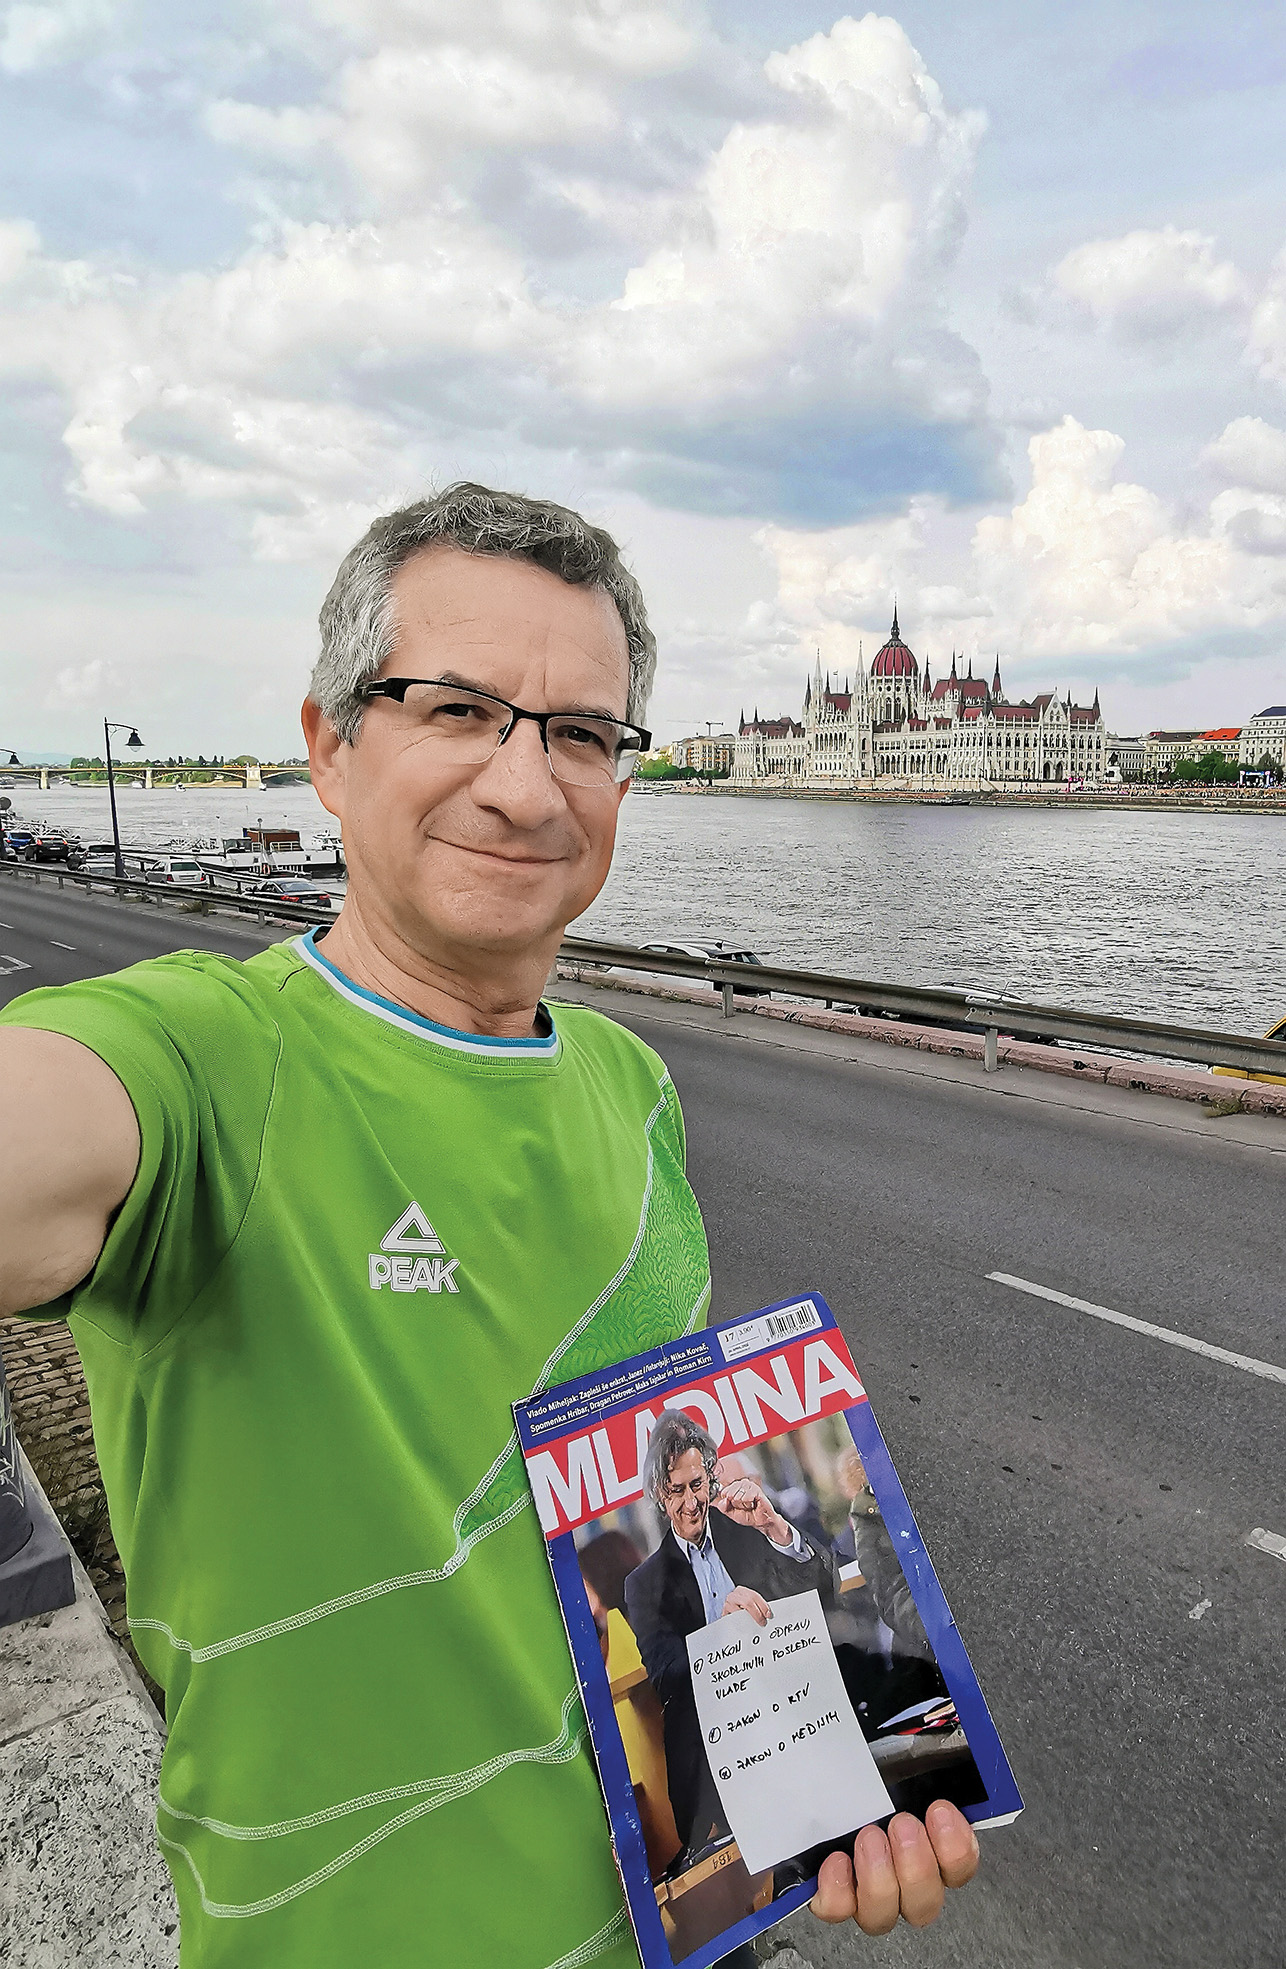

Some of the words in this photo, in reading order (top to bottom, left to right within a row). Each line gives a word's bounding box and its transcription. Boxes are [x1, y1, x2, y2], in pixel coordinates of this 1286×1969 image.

[368, 1253, 461, 1293] PEAK
[724, 1332, 735, 1342] 17
[527, 1407, 548, 1419] Vlado
[547, 1395, 579, 1412] Miheljak:
[670, 1352, 686, 1362] Nika
[686, 1342, 710, 1356] Kovač,
[530, 1415, 567, 1433] Spomenka
[567, 1405, 590, 1419] Hribar,
[589, 1397, 611, 1410] Dragan
[666, 1369, 674, 1377] in
[673, 1362, 697, 1374] Roman
[707, 1639, 742, 1665] ZAKON
[752, 1636, 760, 1645] O
[715, 1677, 751, 1700] VLADE
[727, 1709, 761, 1732] ZAKON
[772, 1703, 780, 1713] O
[788, 1682, 810, 1704] RTV
[736, 1748, 772, 1771] ZAKON
[778, 1741, 786, 1751] O
[791, 1711, 841, 1743] MEDIJIH
